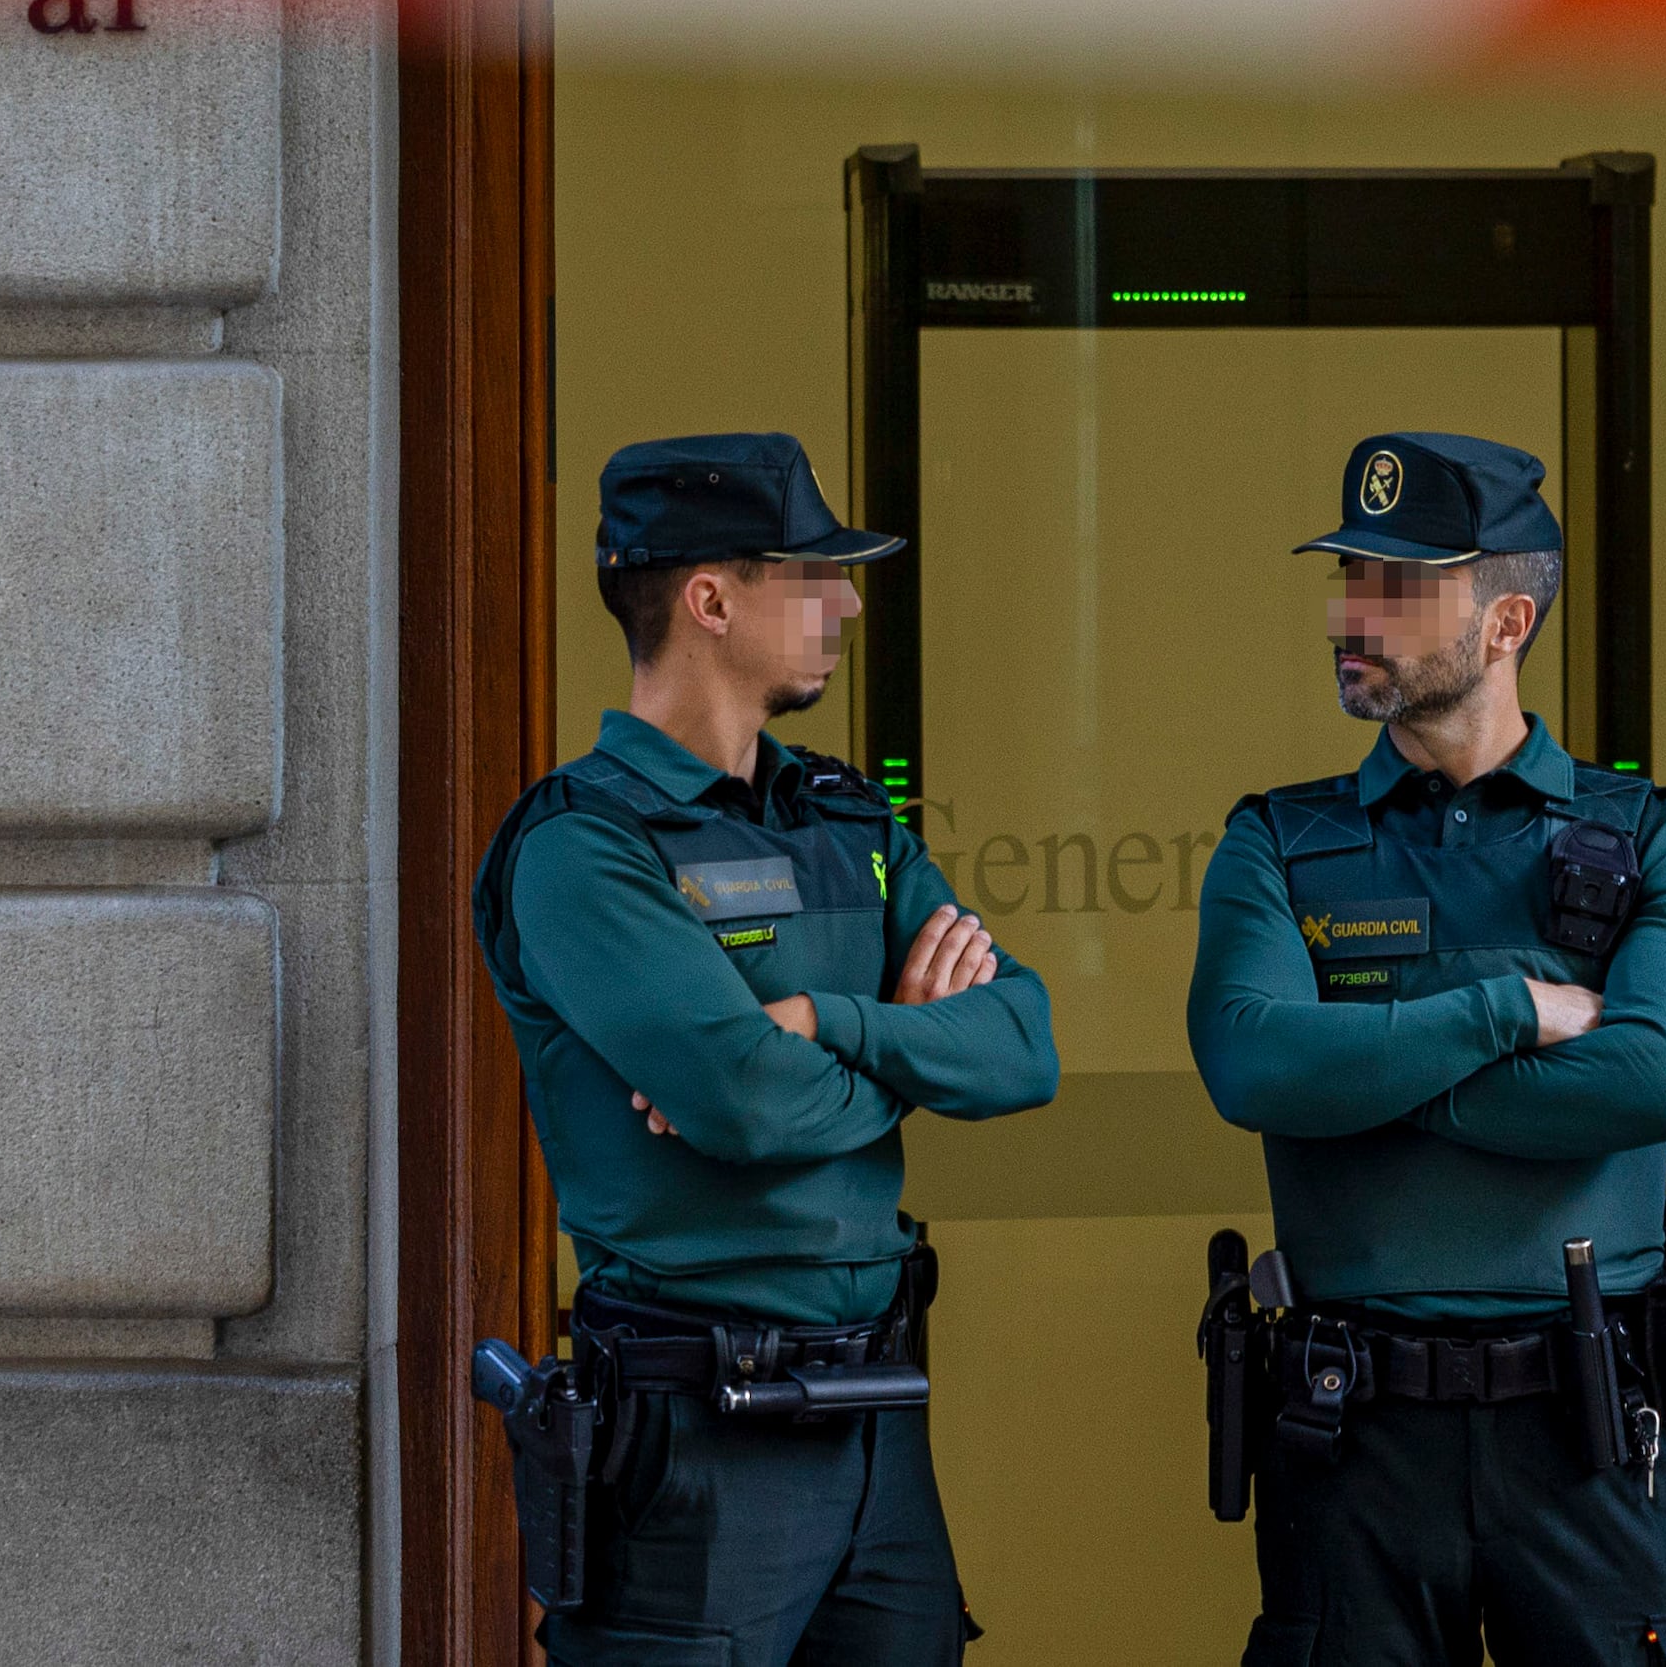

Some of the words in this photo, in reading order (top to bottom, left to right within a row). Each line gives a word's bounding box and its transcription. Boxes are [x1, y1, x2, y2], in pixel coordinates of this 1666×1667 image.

[926, 281, 1034, 302] RANGER
[893, 796, 1218, 917] Gener
[714, 880, 761, 895] GUARDIA
[764, 877, 794, 892] CIVIL
[1332, 920, 1388, 938] GUARDIA
[1390, 919, 1421, 935] CIVIL
